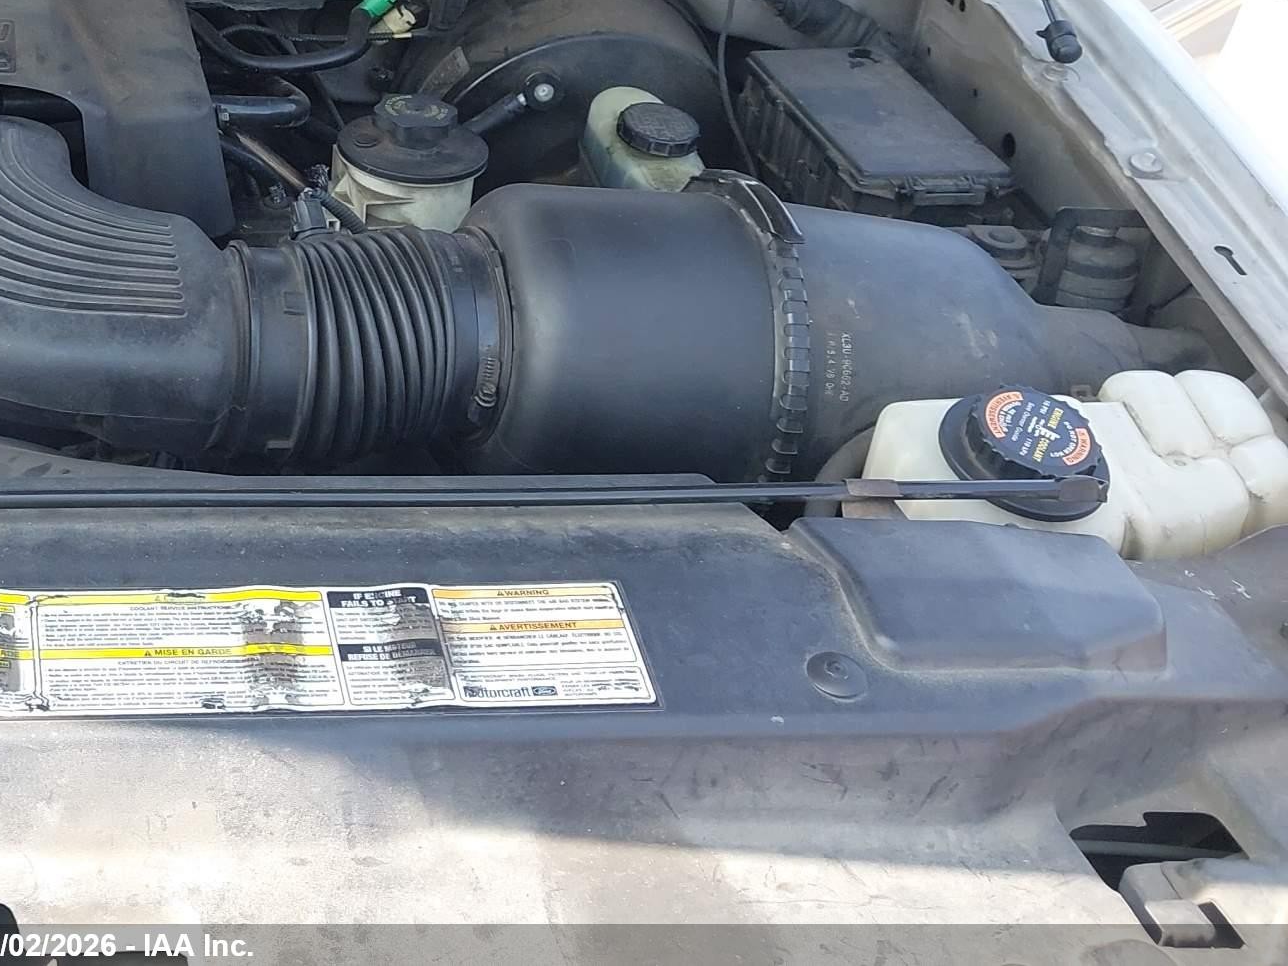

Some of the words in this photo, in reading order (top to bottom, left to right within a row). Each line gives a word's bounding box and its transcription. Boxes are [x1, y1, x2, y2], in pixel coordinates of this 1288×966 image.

[1025, 401, 1036, 412] See
[1018, 411, 1031, 428] Owner
[1047, 407, 1065, 430] ENGINE
[1011, 426, 1024, 442] Guide
[1032, 438, 1050, 462] COOLANT
[1065, 438, 1089, 463] WARNING
[341, 599, 369, 608] FAILS
[371, 599, 385, 607] TO
[499, 621, 577, 631] AVERTISSEMENT
[197, 648, 232, 656] GARDE
[347, 653, 379, 661] REFUSE
